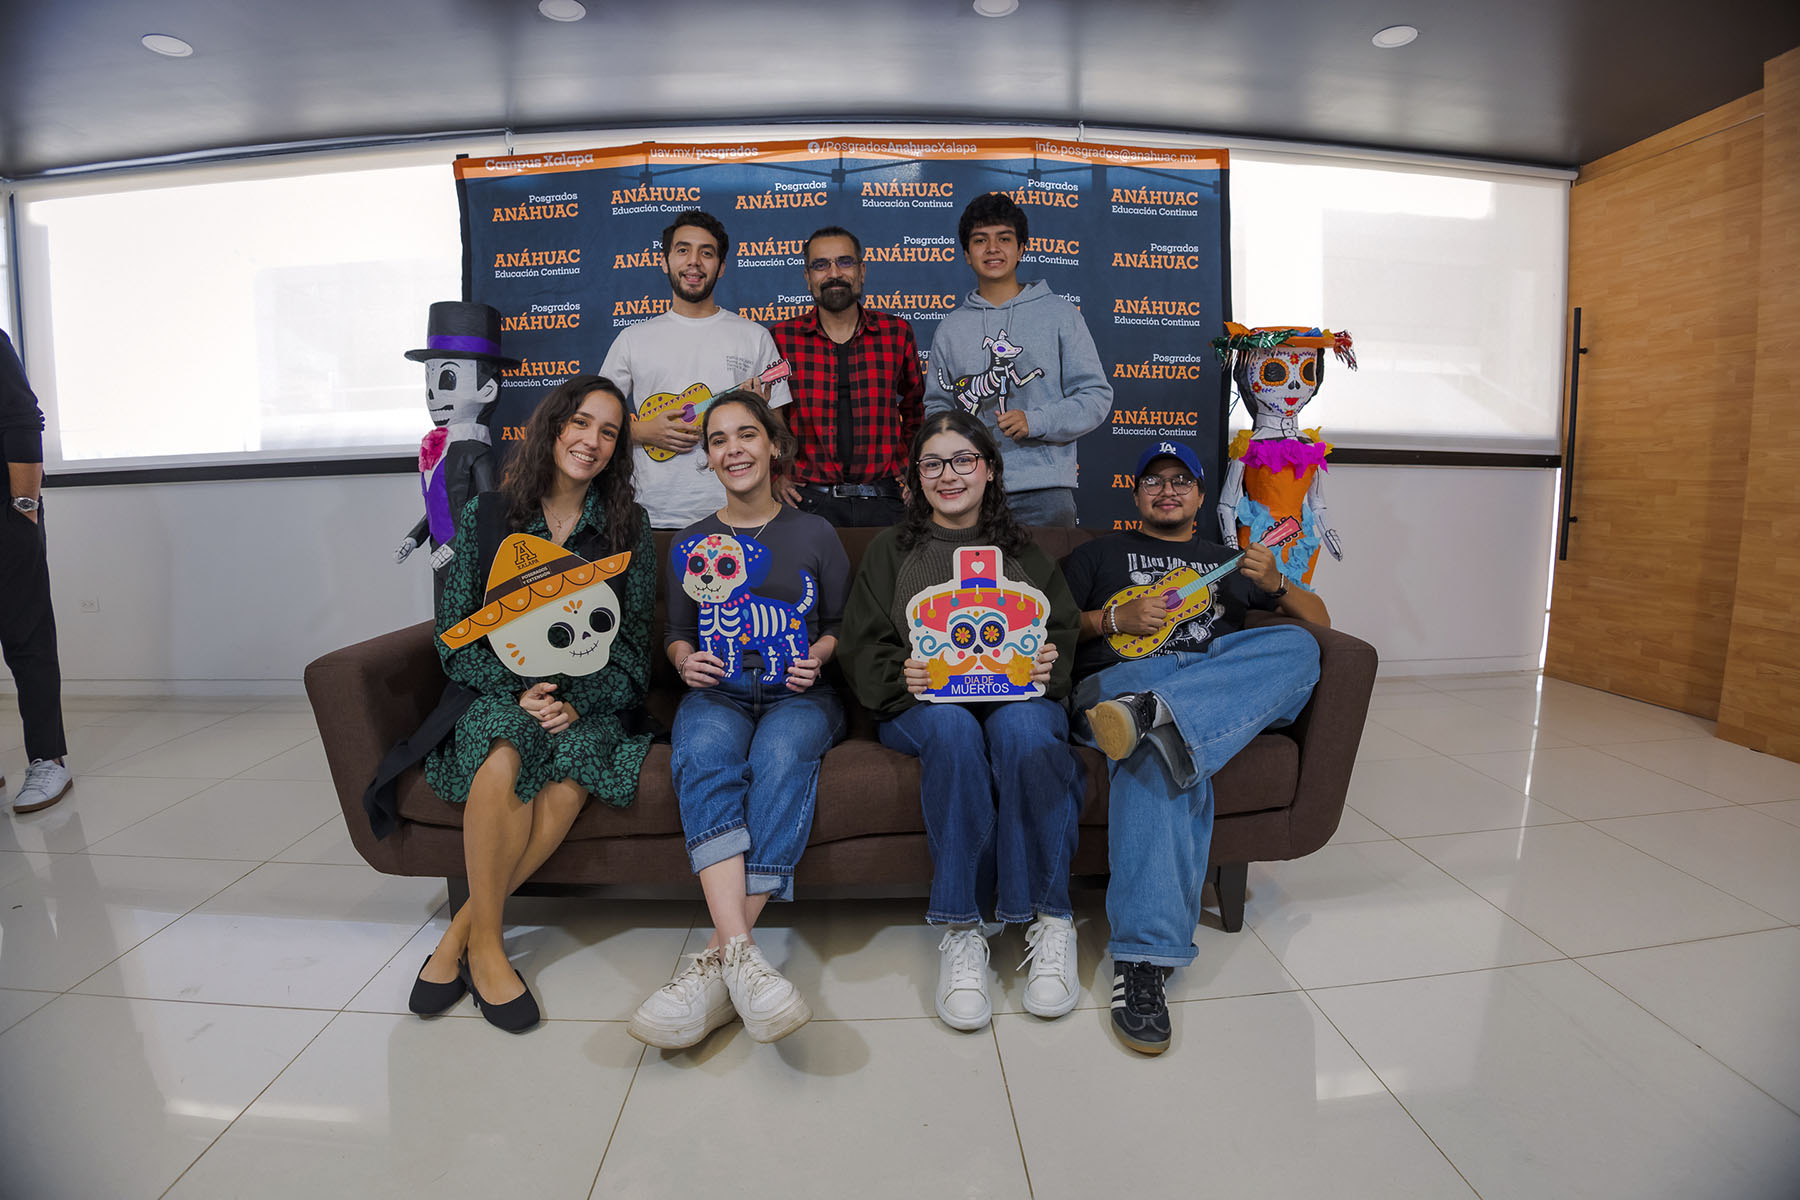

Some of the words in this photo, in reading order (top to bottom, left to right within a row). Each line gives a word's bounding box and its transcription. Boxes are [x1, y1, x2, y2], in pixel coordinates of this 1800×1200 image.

[650, 145, 759, 161] uav.mx/posgrados
[1035, 141, 1197, 164] info.posgrados@anahuac.mx
[485, 158, 542, 173] Campus
[543, 152, 594, 168] Xalapa
[775, 181, 827, 193] Posgrados
[861, 178, 953, 197] ANÁHUAC
[1027, 178, 1079, 192] Posgrados
[529, 192, 578, 204] Posgrados
[610, 183, 701, 205] ANÁHUAC
[735, 190, 828, 210] ANÁHUAC
[989, 186, 1079, 208] ÁHUAC
[1111, 186, 1199, 206] ANÁHUAC
[612, 204, 659, 216] Educación
[660, 203, 701, 213] Contin
[862, 199, 910, 208] Educación
[911, 199, 953, 208] Continua
[1112, 205, 1158, 216] Educación
[1158, 207, 1198, 217] Continua
[492, 202, 579, 222] ANÁHUAC
[737, 237, 809, 257] ANÁHU
[903, 235, 955, 246] Posgrados
[1025, 237, 1079, 255] HUAC
[1150, 243, 1199, 254] Posgrados
[494, 248, 581, 268] ANÁHUAC
[613, 248, 664, 269] ANÁH
[863, 243, 955, 262] ANÁHUAC
[1038, 254, 1079, 266] Continua
[1111, 250, 1199, 270] ANÁHUAC
[737, 257, 785, 268] Educación
[495, 268, 540, 279] Educación
[540, 267, 580, 277] Continua
[531, 302, 580, 313] Posgrados
[612, 295, 671, 316] ANÁH
[777, 294, 814, 305] Posgra
[863, 290, 956, 309] ANÁHUAC
[1113, 296, 1200, 316] ANÁHUAC
[739, 302, 814, 321] ANÁHU
[913, 311, 949, 320] Continu
[1114, 316, 1159, 326] Educación
[1161, 317, 1200, 327] Continua
[1152, 353, 1200, 364] Posgrados
[1113, 361, 1200, 380] ANÁHUAC
[542, 377, 568, 387] Conti
[1112, 407, 1198, 426] ANÁHUAC
[1112, 426, 1157, 436] Educación
[1158, 427, 1197, 437] Continua
[964, 676, 980, 684] DIA
[981, 675, 994, 684] DE
[951, 683, 1009, 694] MUERTOS
